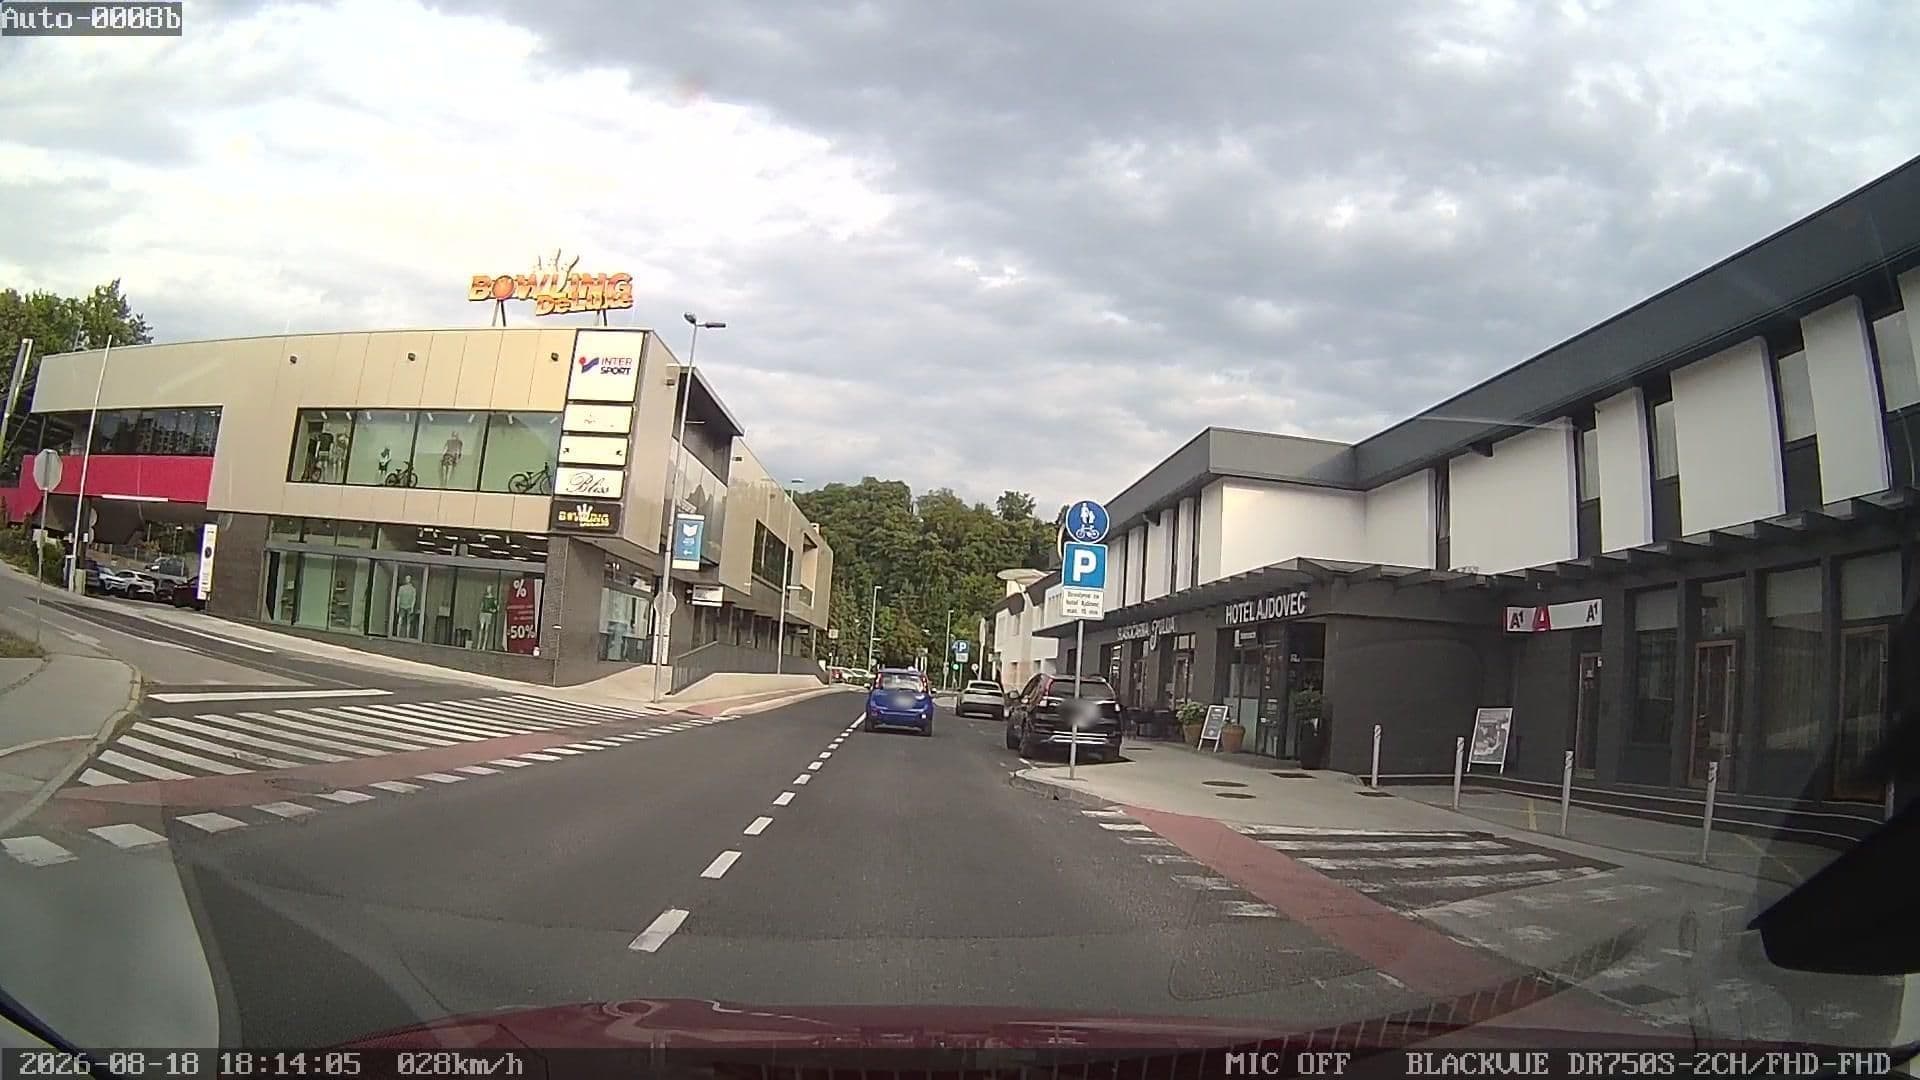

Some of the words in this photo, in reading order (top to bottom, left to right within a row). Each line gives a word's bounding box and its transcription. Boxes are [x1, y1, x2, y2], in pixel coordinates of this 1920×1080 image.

[469, 273, 633, 301] BOWLING
[600, 366, 631, 375] SPORT
[601, 357, 632, 366] INTER
[566, 472, 609, 494] Bliss
[1073, 549, 1097, 582] P
[1225, 601, 1255, 625] HOTEL
[1256, 591, 1306, 620] AJDOVEC
[1586, 602, 1599, 622] A1
[1510, 611, 1524, 629] A1
[507, 625, 536, 639] -50%
